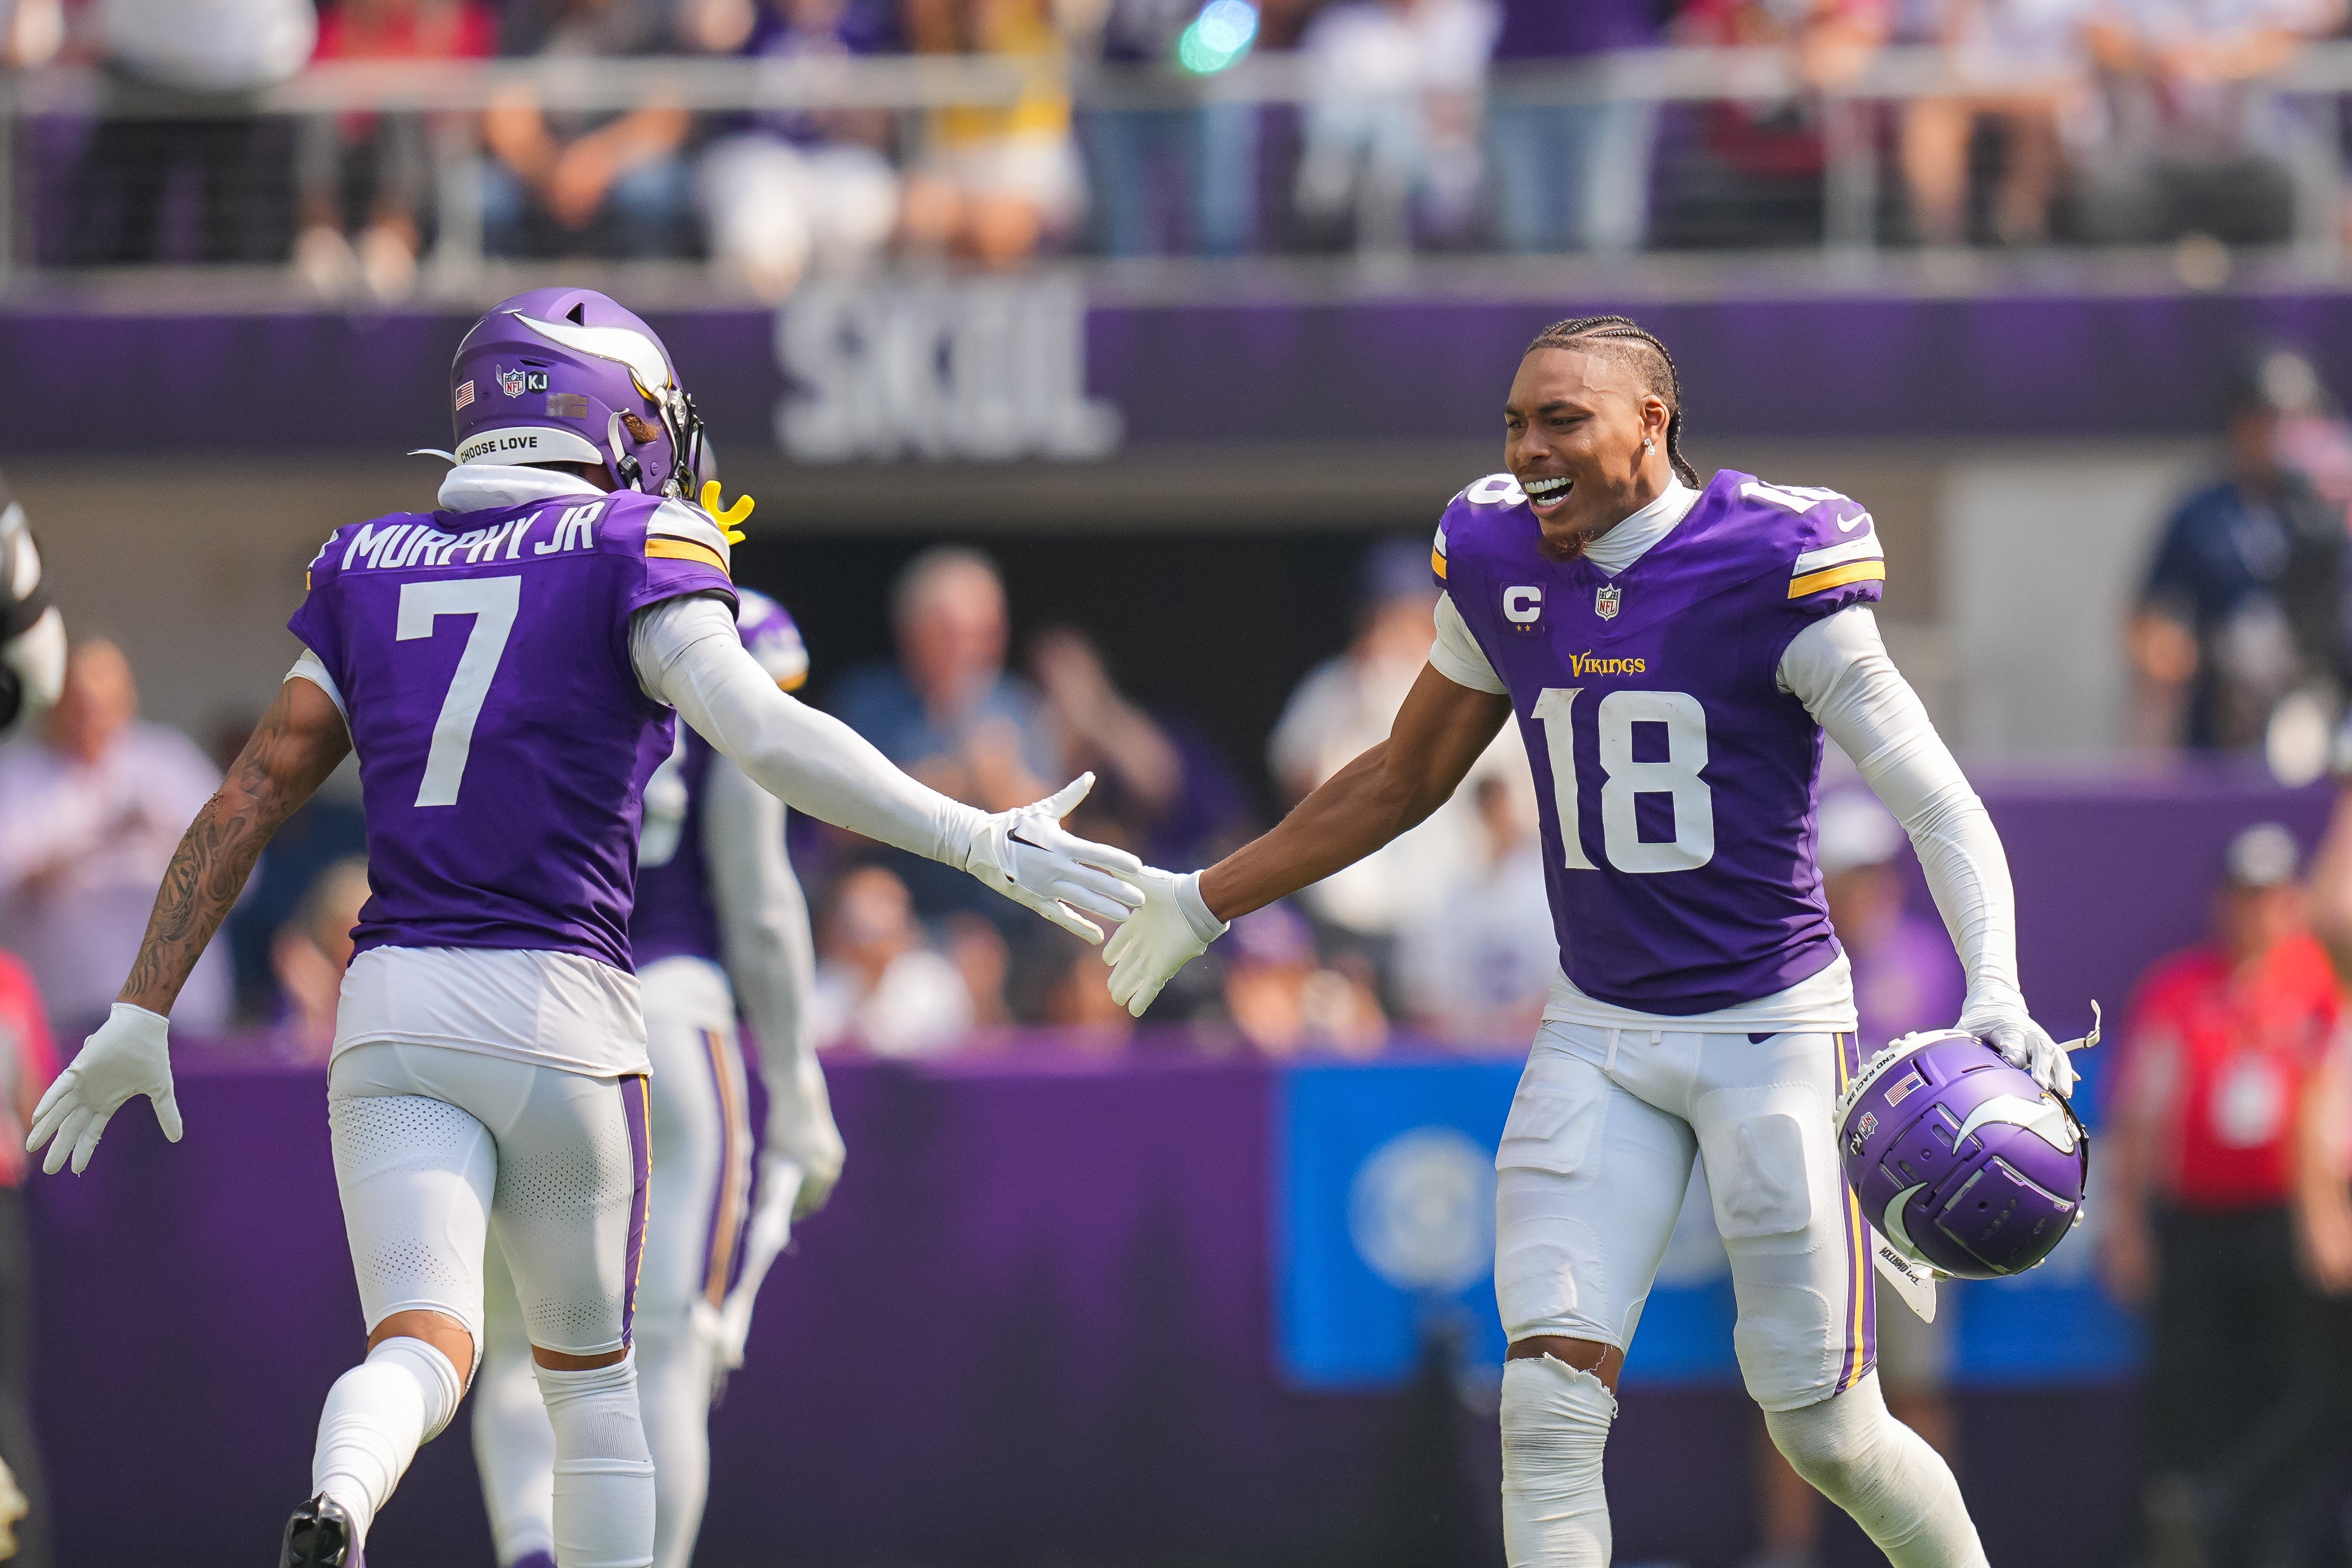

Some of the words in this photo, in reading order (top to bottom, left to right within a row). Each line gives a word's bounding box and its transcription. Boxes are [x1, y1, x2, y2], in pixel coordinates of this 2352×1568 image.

[507, 381, 522, 393] NFL
[528, 374, 547, 389] KJ
[460, 441, 497, 464] CHOOSE
[499, 436, 538, 450] LOVE
[341, 510, 543, 571] MURPHY
[534, 501, 606, 556] JR
[1503, 586, 1542, 623] C
[1599, 599, 1615, 614] NFL
[1569, 648, 1646, 677] VIKINGS
[396, 575, 522, 807] 7
[1530, 687, 1715, 873] 18
[1876, 1053, 1896, 1069] END
[1847, 1069, 1875, 1107] RACISM
[1861, 1115, 1873, 1130] NFL
[1850, 1133, 1862, 1155] KJ
